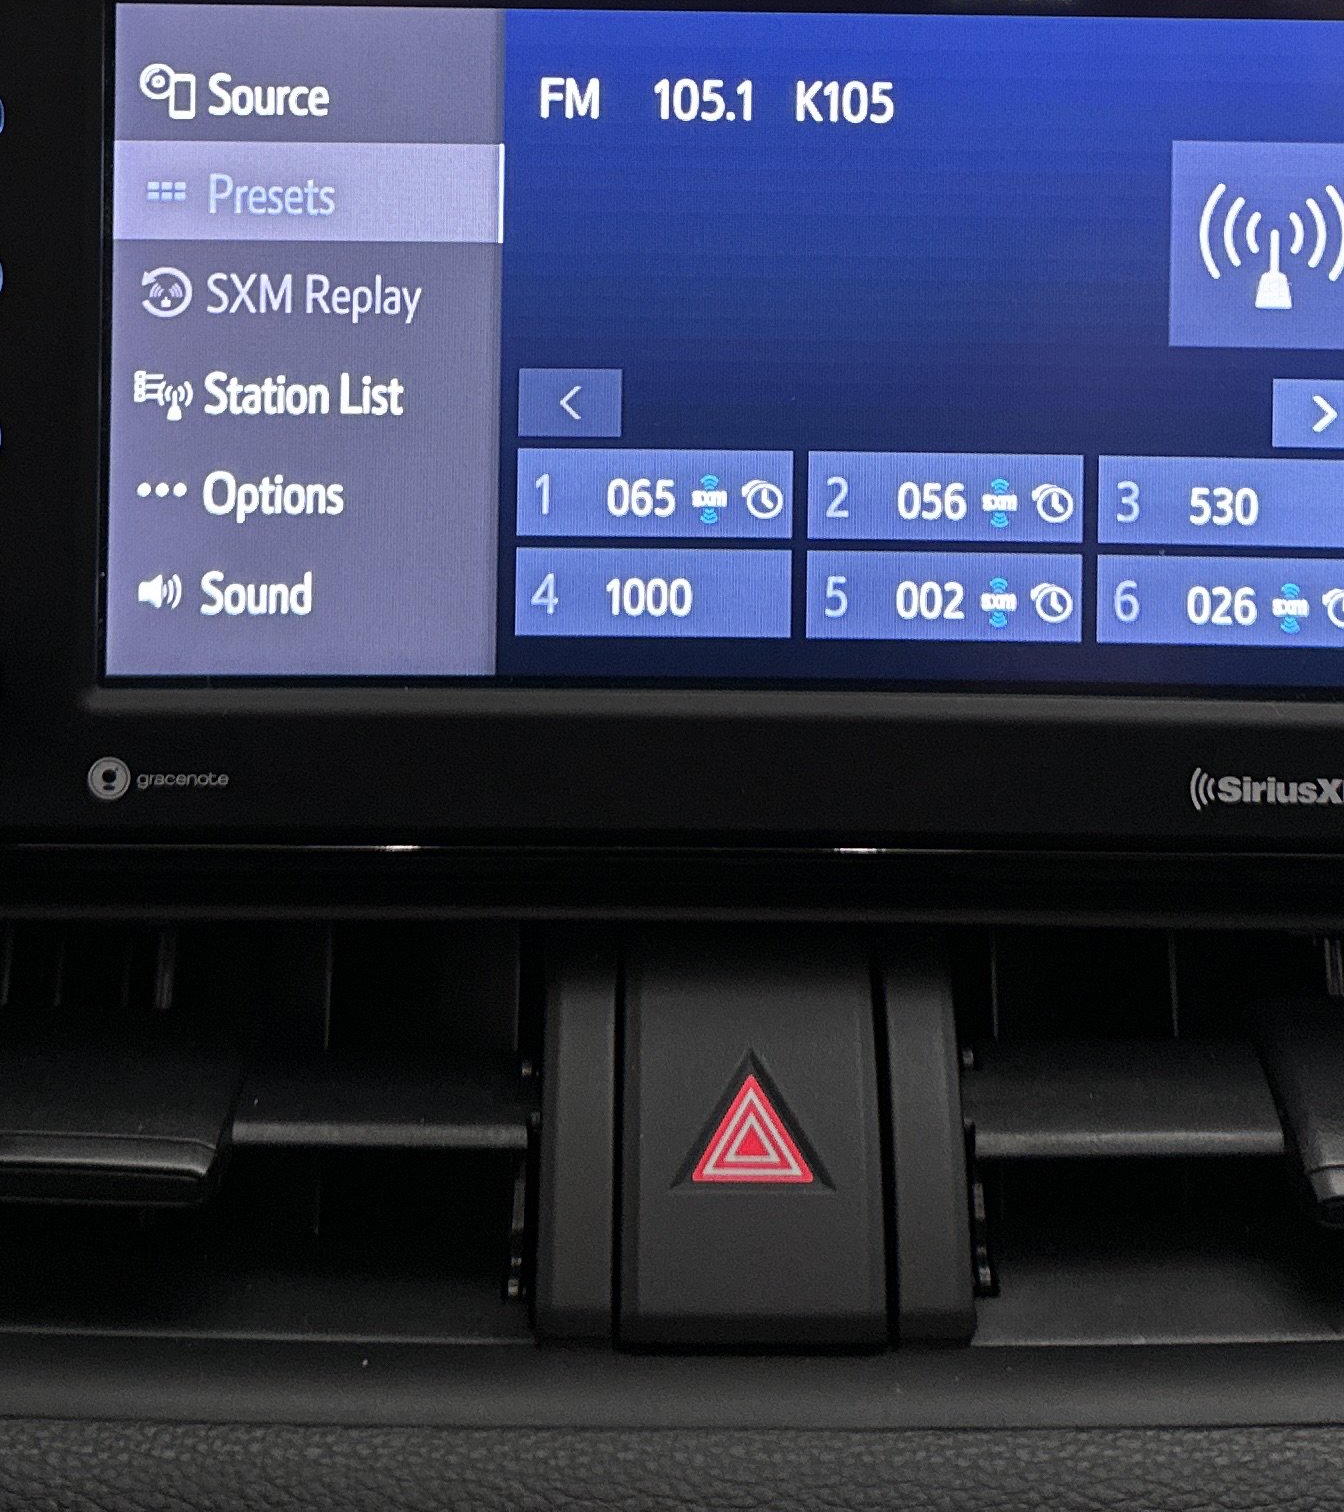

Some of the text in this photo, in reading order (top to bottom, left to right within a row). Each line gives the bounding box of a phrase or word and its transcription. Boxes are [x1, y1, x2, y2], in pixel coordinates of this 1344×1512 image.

[207, 73, 330, 117] Source
[539, 77, 895, 124] FM 105.1 K105
[208, 173, 336, 217] Presets
[206, 273, 422, 324] SXM Replay
[203, 371, 405, 416] Station List
[202, 470, 344, 524] Options
[535, 473, 551, 516] 1
[606, 477, 676, 517] 065
[825, 476, 850, 519] 2
[897, 481, 968, 521] 056
[1116, 480, 1259, 526] 3 530
[199, 570, 313, 616] Sound
[530, 573, 693, 618] 4 1000
[824, 575, 848, 618] 5
[896, 581, 966, 620] 002
[1113, 580, 1140, 623] 6
[1186, 586, 1258, 626] 026
[136, 771, 230, 790] gracenote
